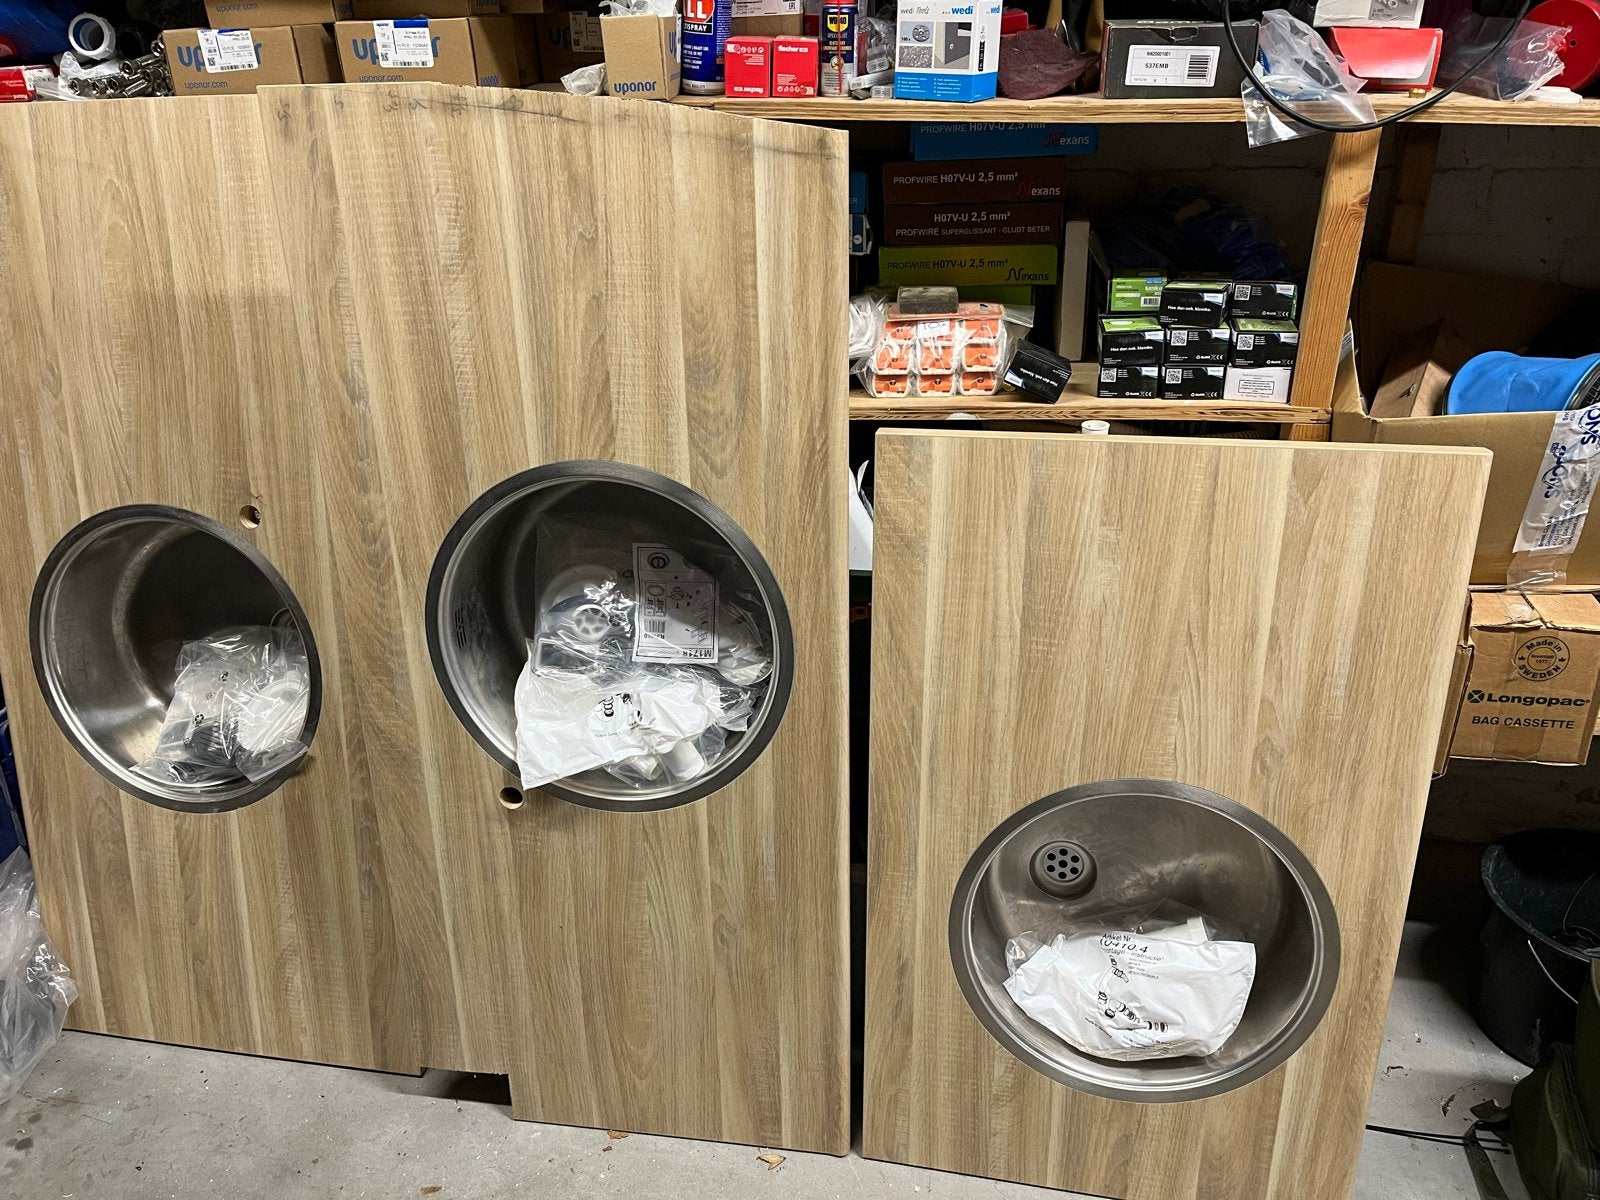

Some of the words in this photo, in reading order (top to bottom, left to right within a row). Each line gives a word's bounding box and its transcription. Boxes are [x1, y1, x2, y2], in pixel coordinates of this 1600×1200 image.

[216, 2, 258, 12] uponor.com
[951, 5, 974, 15] wedi
[184, 81, 228, 90] uponor.com
[613, 81, 657, 95] uponor
[920, 124, 967, 133] PROFWIRE
[1042, 132, 1090, 147] Nexans
[893, 175, 938, 184] PROFWIRE
[940, 173, 976, 183] H07V-U
[978, 172, 994, 182] 2,5
[1016, 182, 1060, 196] Nexans
[934, 213, 969, 223] H07V-U
[971, 211, 987, 222] 2,5
[896, 228, 939, 237] PROFWIRE
[941, 227, 997, 236] SUPERGLISSANT
[1027, 225, 1051, 233] BETER
[887, 262, 931, 270] PROFWIRE
[933, 259, 967, 269] H07V-U
[969, 258, 985, 268] 2,5
[1005, 267, 1049, 282] Nexans
[1525, 640, 1553, 650] Made
[1554, 643, 1562, 652] in
[1518, 664, 1561, 679] SWEDEN
[1472, 715, 1500, 725] BAG
[1504, 717, 1575, 729] CASSETTE
